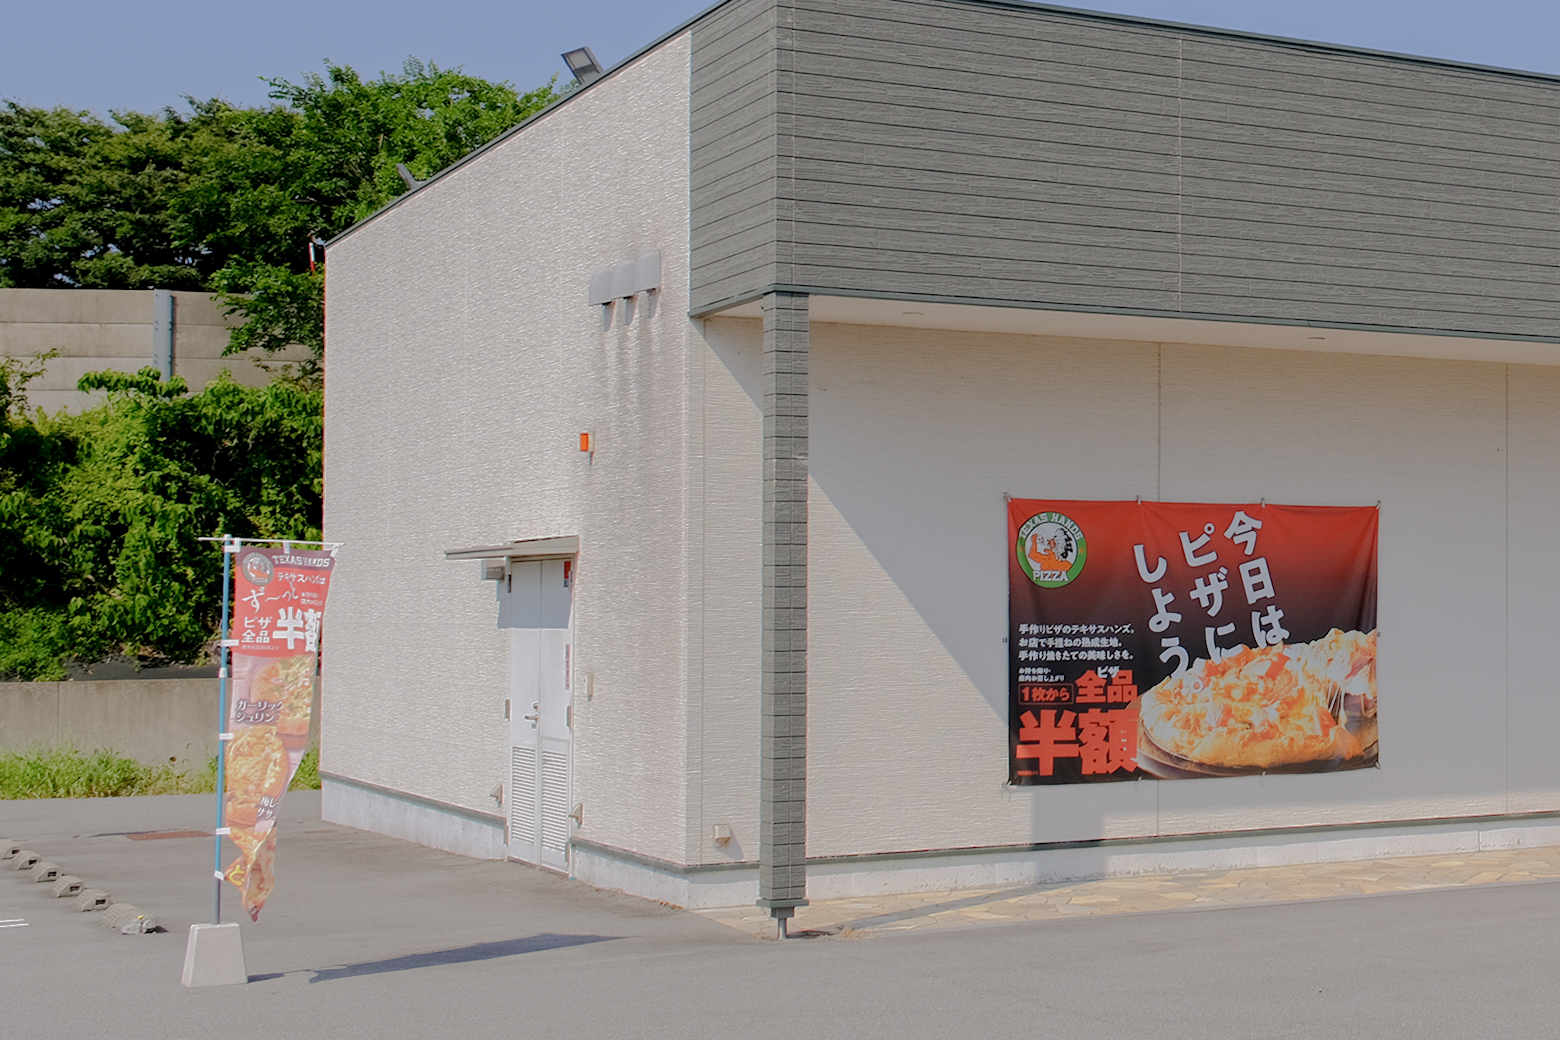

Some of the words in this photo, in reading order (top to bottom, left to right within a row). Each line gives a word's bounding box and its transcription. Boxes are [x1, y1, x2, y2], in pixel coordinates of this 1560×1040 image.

[1018, 512, 1049, 540] TEXAS
[1050, 512, 1084, 541] HANDS
[272, 554, 303, 566] TEXAS
[1032, 570, 1069, 581] PIZZA
[1223, 510, 1291, 647] 今日は
[1178, 522, 1244, 666] ピザに
[244, 616, 273, 630] ピザ
[1018, 623, 1136, 635] 手作りピザのテキサスハンズ。
[241, 629, 270, 644] 全品
[1018, 649, 1135, 661] 手作り焼きたての美味しさを。
[1097, 665, 1121, 678] ピザ
[1021, 686, 1071, 702] 1枚から
[1075, 669, 1139, 704] 全品
[1016, 708, 1140, 777] 半額
